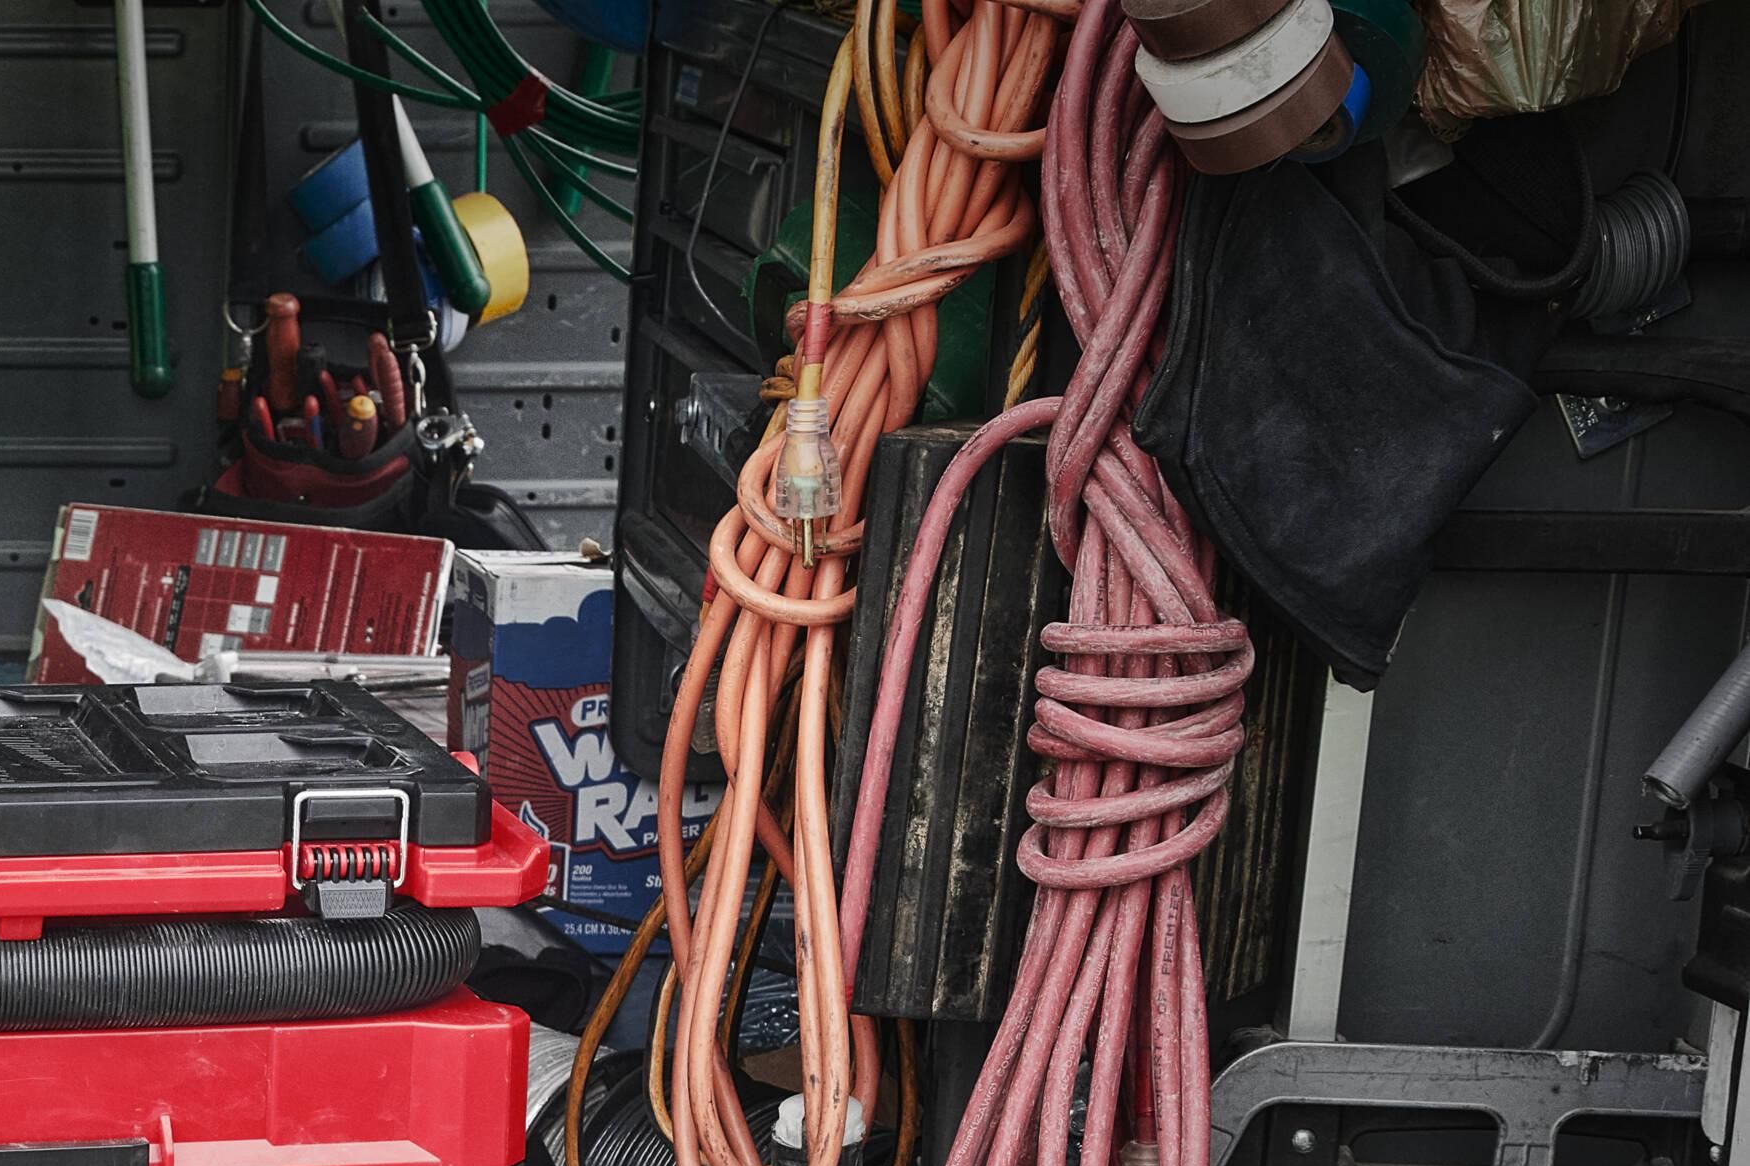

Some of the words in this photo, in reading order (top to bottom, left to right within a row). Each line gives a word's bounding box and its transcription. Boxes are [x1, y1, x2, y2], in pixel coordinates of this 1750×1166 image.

[581, 699, 609, 721] PR
[643, 823, 700, 845] PAER
[572, 864, 593, 875] 200
[585, 924, 598, 935] CM
[600, 924, 606, 935] X
[1161, 883, 1184, 976] PREMIER
